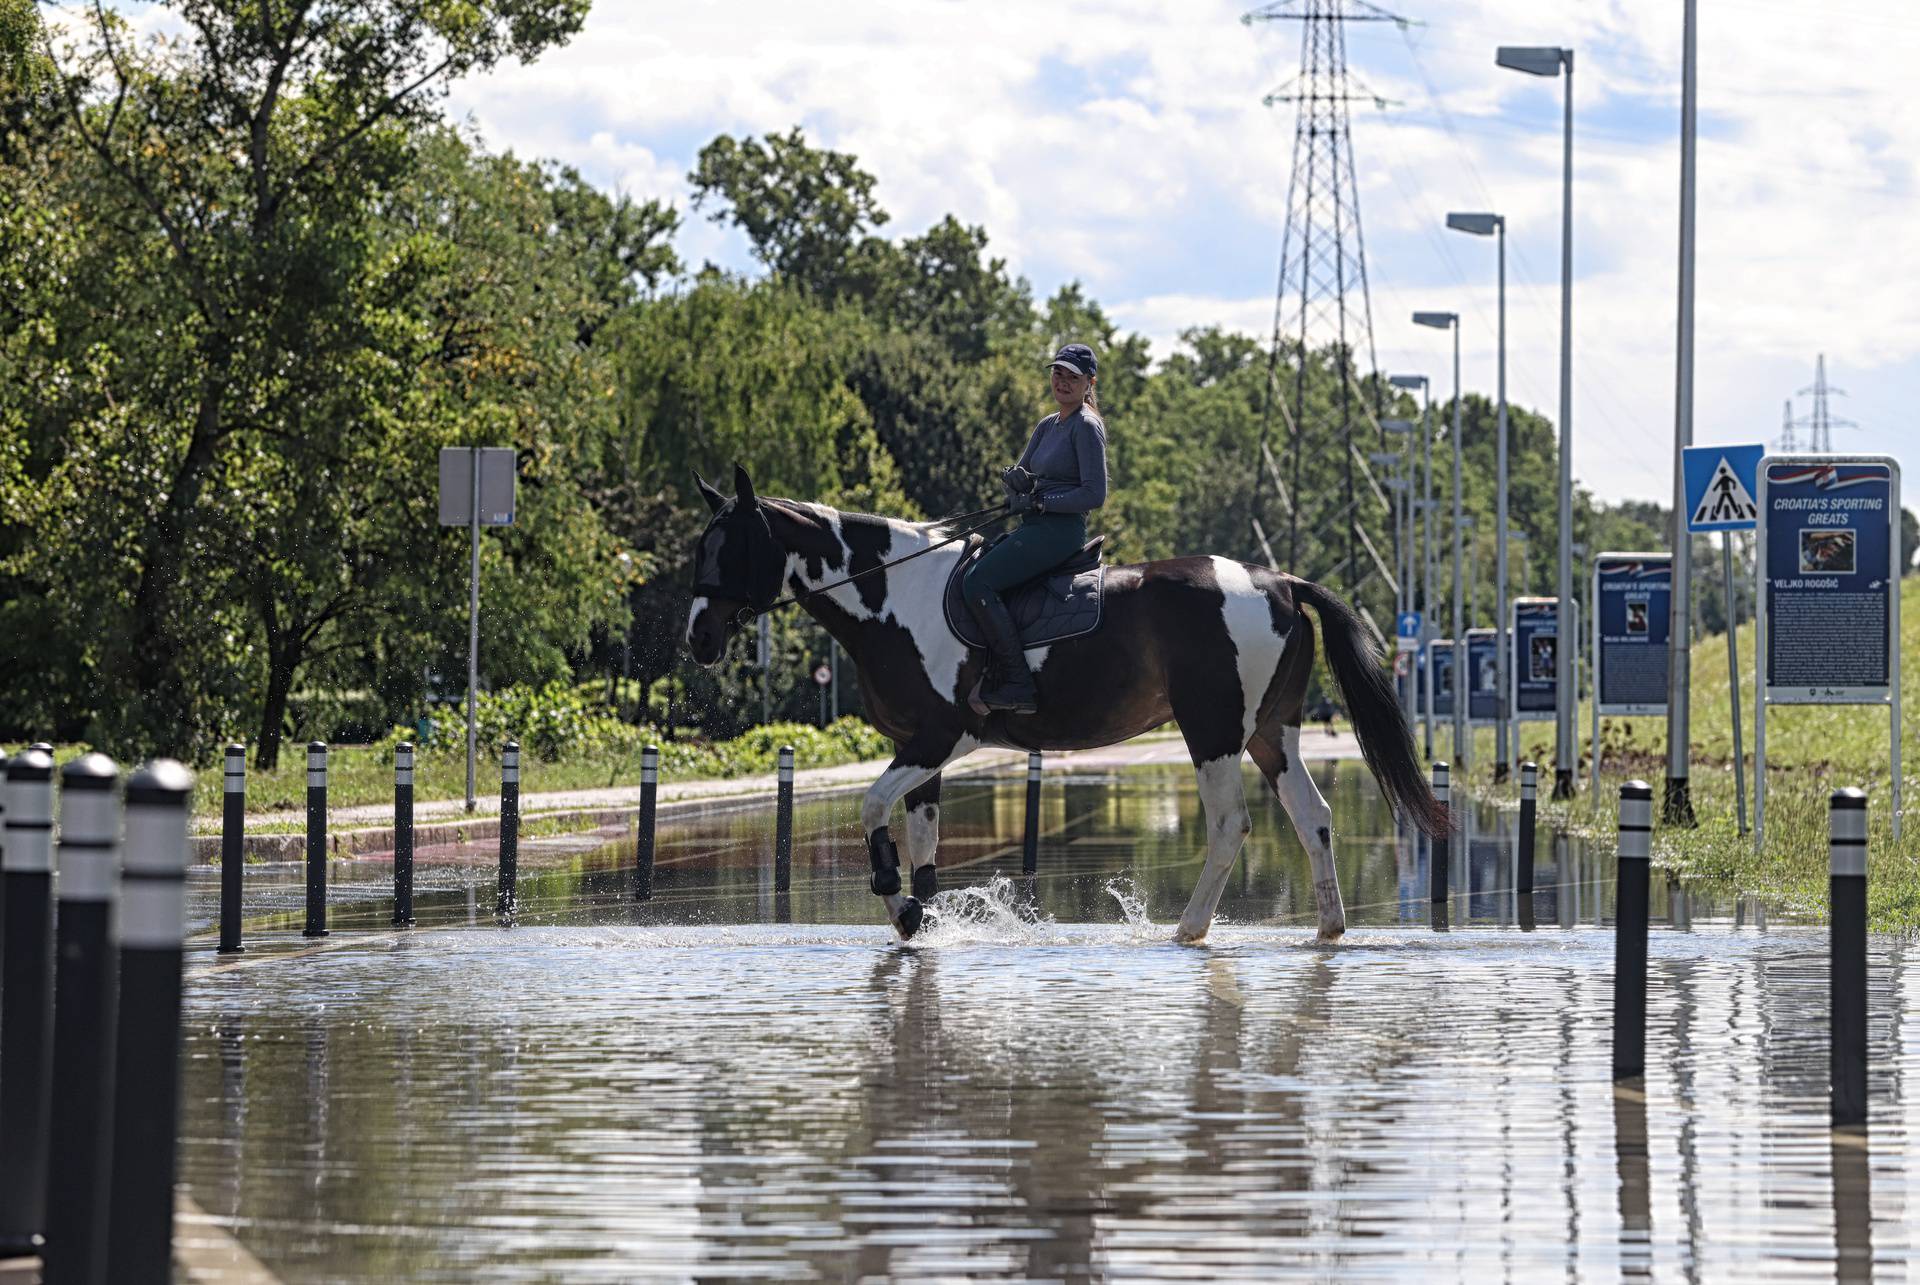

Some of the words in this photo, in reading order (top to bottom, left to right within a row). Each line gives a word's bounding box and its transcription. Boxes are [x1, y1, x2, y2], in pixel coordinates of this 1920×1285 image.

[1774, 498, 1828, 510] CROATIA'S
[1830, 498, 1882, 510] SPORTING
[1808, 513, 1849, 525] GREATS
[1774, 579, 1804, 589] VELJKO
